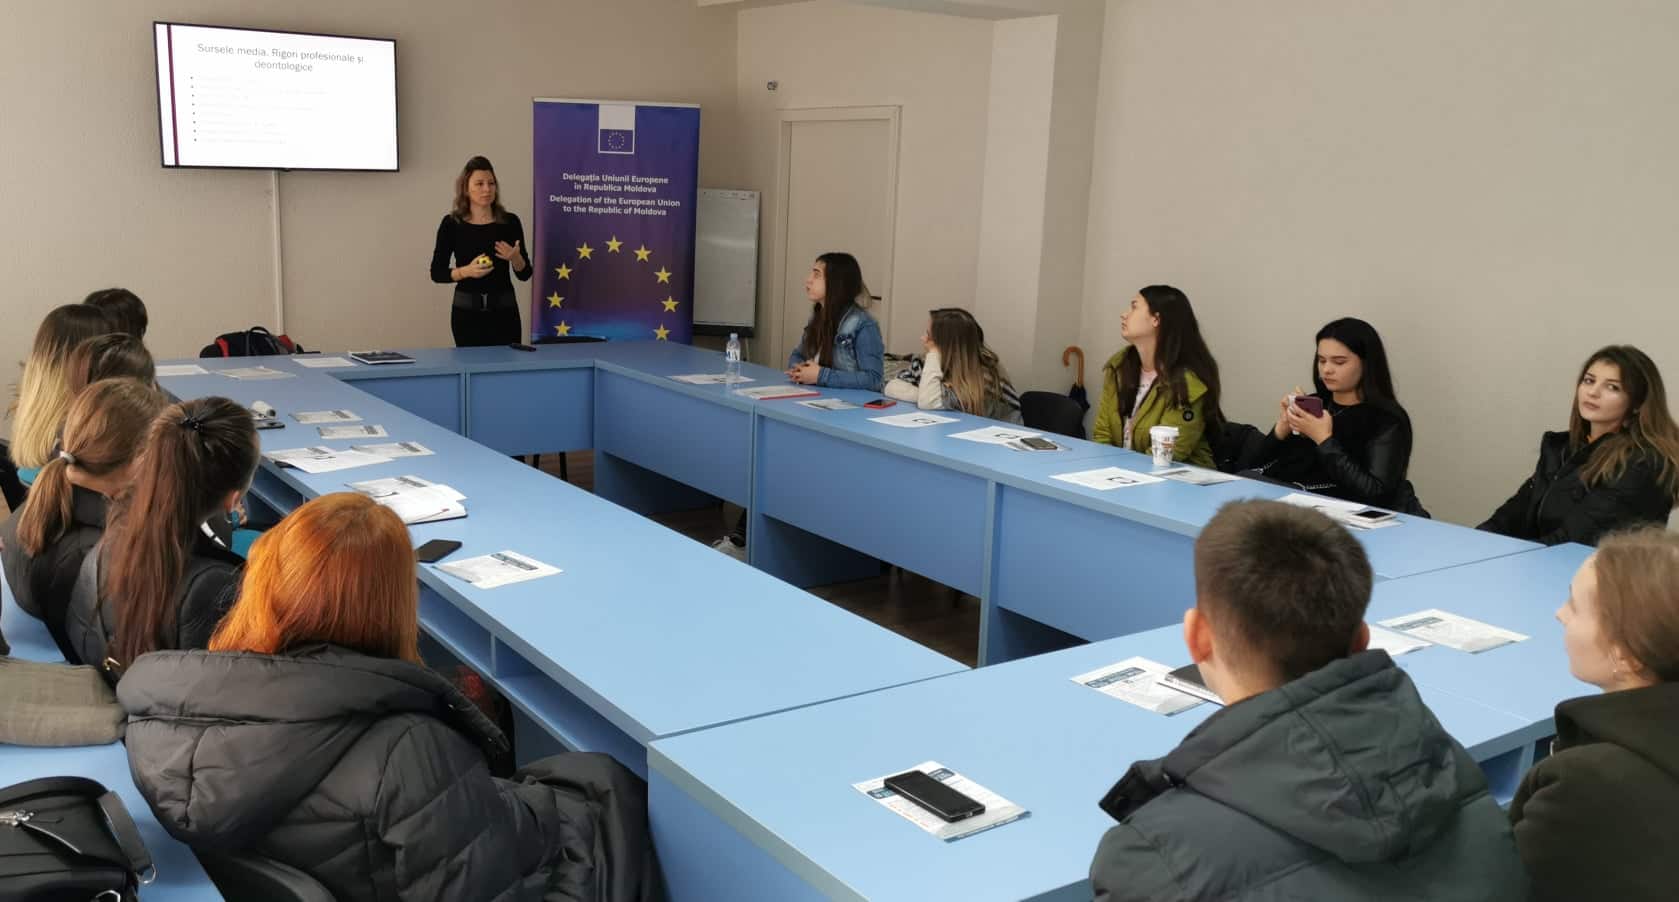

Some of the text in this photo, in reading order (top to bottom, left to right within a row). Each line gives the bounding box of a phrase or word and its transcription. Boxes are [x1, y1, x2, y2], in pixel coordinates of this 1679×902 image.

[197, 43, 234, 55] Sursele
[271, 48, 298, 59] Rigori
[301, 50, 355, 63] profesionale
[254, 60, 313, 72] deontologice
[602, 174, 630, 182] Uniunii
[632, 175, 669, 185] Europene
[583, 183, 622, 193] Republica
[624, 185, 657, 193] Moldova
[549, 195, 592, 205] Delegation
[603, 196, 617, 204] the
[618, 197, 656, 207] European
[657, 199, 681, 207] Union
[588, 206, 622, 215] Republic
[633, 207, 667, 216] Moldova
